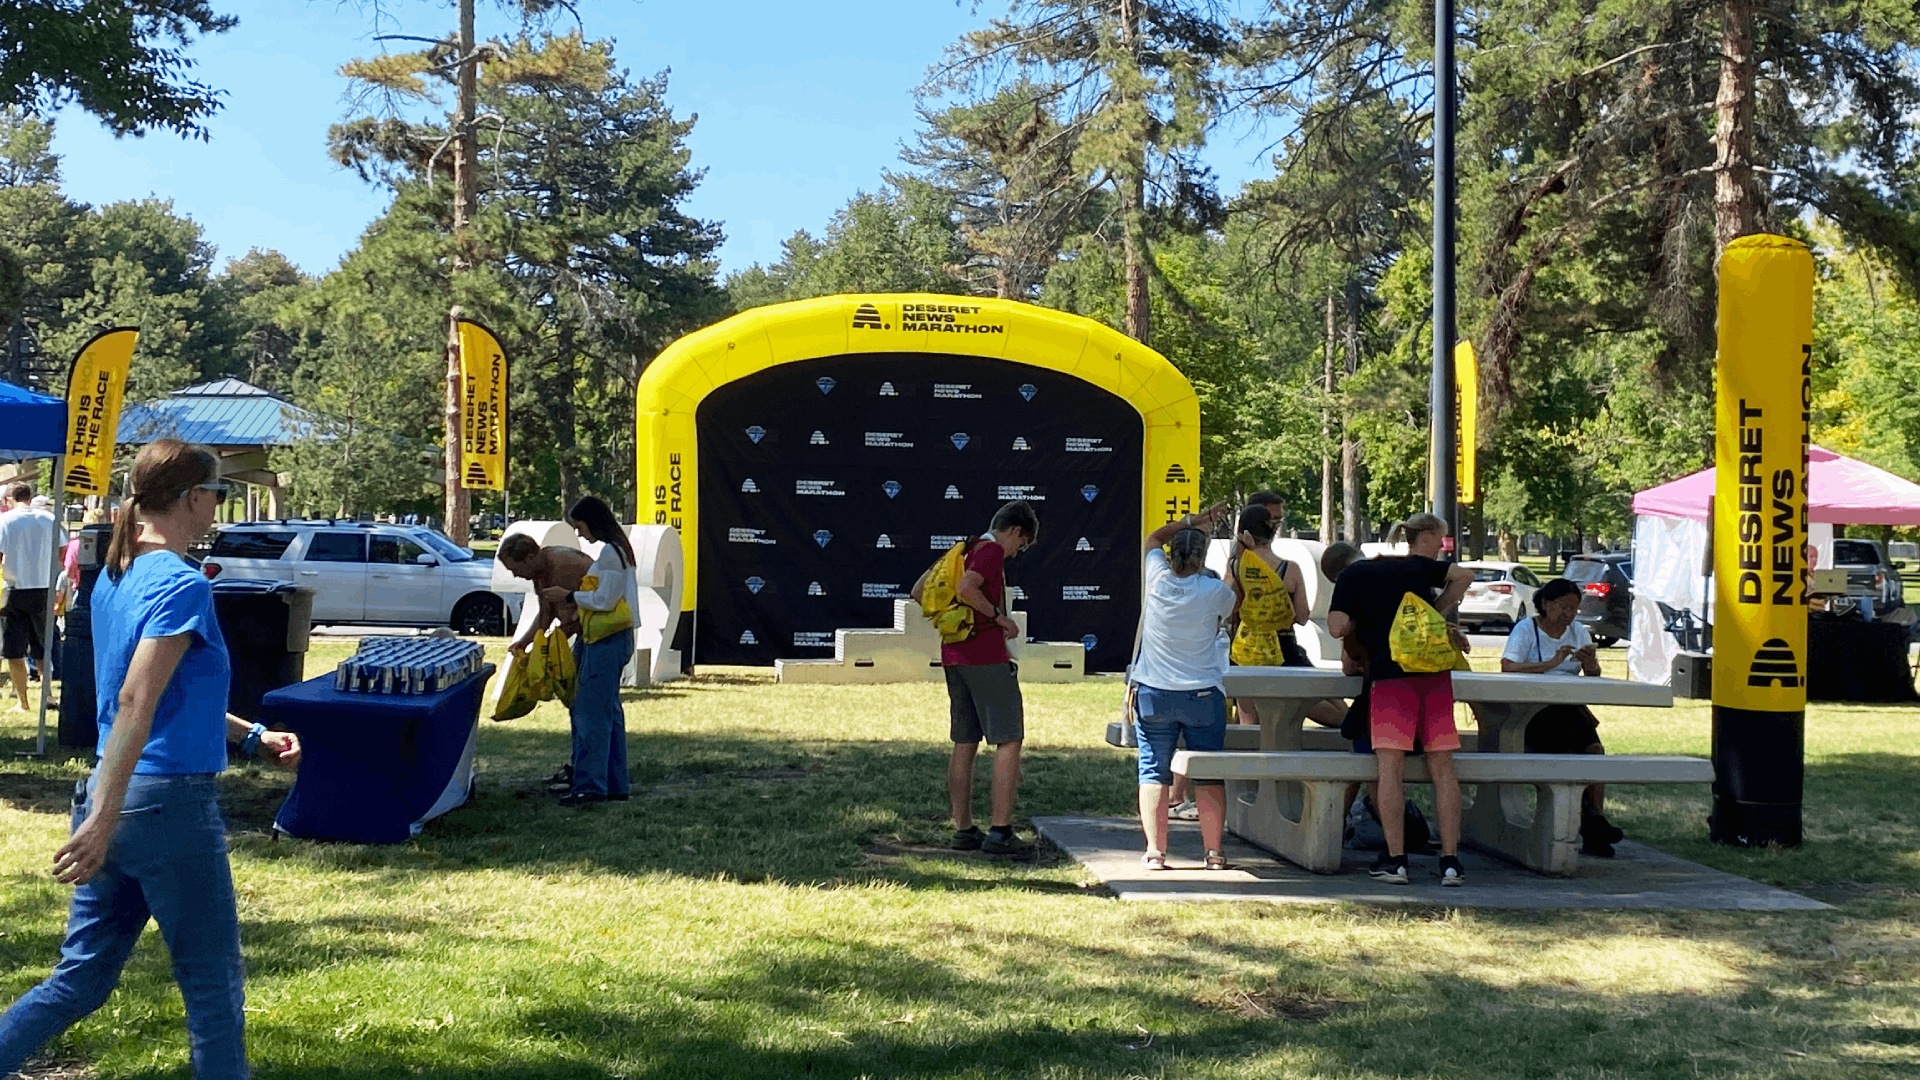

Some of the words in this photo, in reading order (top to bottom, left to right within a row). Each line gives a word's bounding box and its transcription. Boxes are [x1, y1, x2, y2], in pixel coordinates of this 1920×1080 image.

[902, 304, 981, 314] DESERET
[902, 313, 956, 322] NEWS
[902, 323, 1004, 333] MARATHON
[79, 395, 91, 411] IS
[85, 422, 100, 458] THE
[94, 370, 109, 420] RACE
[489, 354, 502, 455] MARATHON
[72, 415, 88, 456] THIS
[475, 401, 488, 454] NEWS
[655, 485, 667, 505] IS
[670, 453, 682, 513] RACE
[1739, 399, 1762, 604] DESERET
[1772, 469, 1794, 606] NEWS
